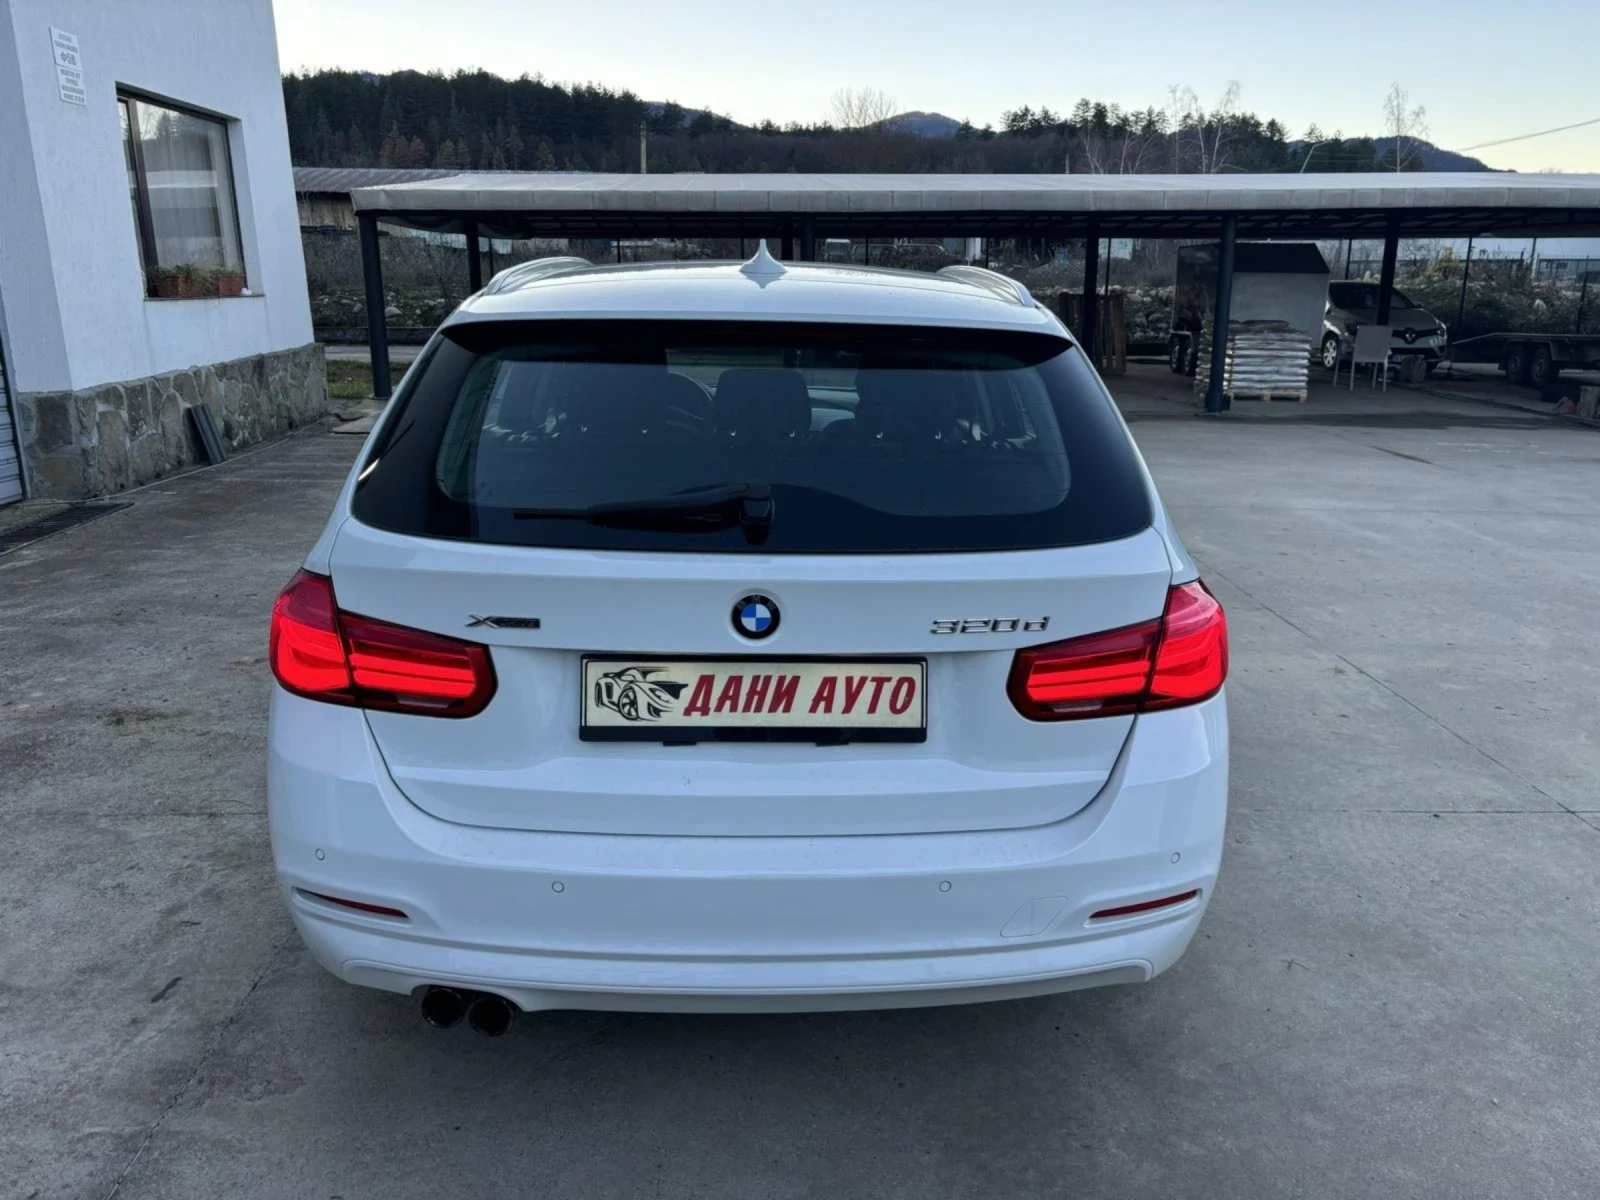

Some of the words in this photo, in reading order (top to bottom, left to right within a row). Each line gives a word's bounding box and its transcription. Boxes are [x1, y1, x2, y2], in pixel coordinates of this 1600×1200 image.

[930, 615, 1051, 635] 320d
[682, 674, 801, 717] ДАНИ
[808, 675, 917, 715] АУТО
